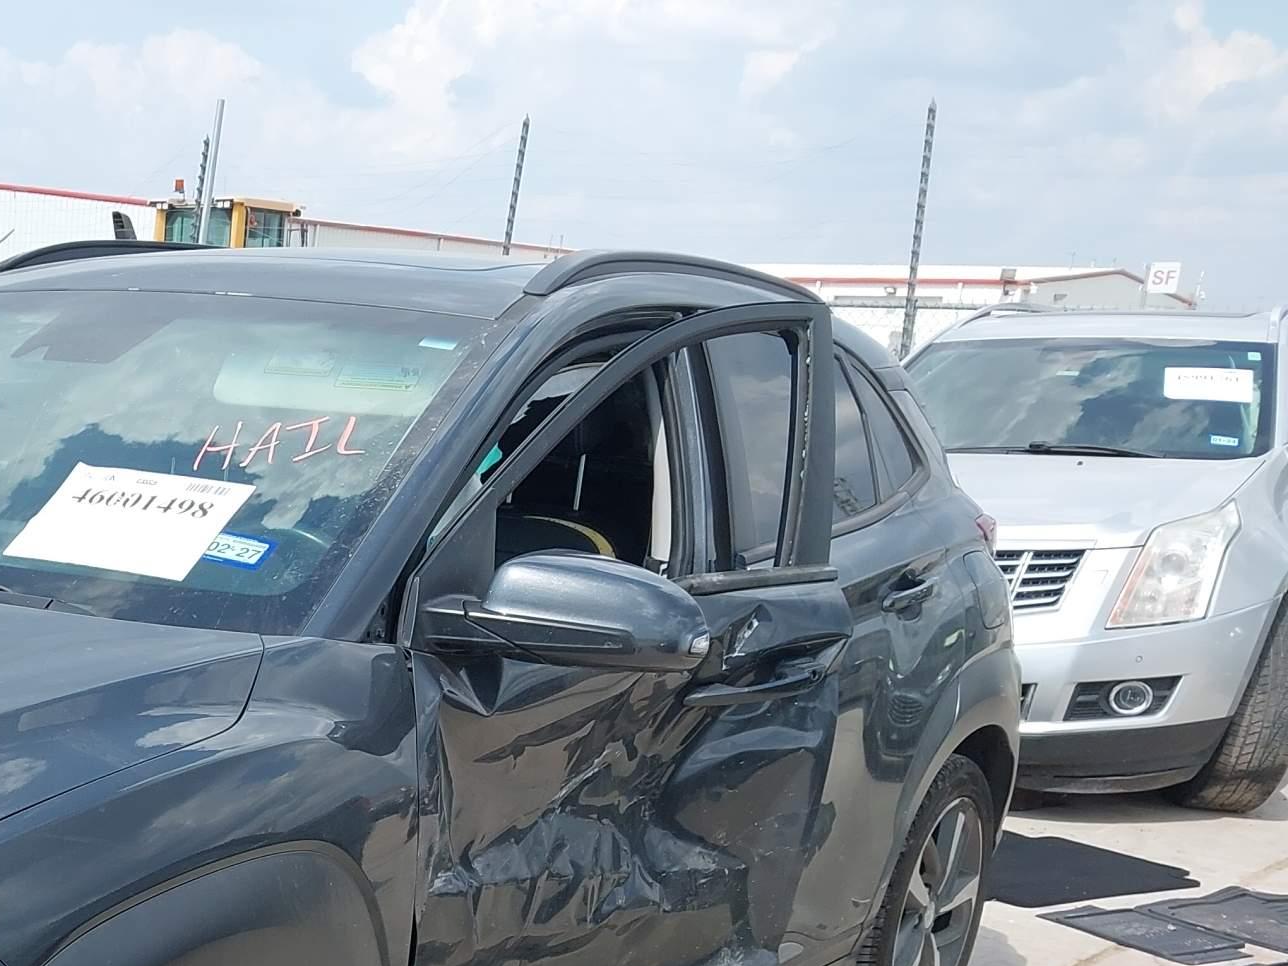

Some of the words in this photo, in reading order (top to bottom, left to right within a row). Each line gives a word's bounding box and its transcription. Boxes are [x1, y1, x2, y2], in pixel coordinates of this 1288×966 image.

[1152, 270, 1177, 285] SF
[193, 415, 366, 472] HAIL
[72, 488, 215, 519] 46001498
